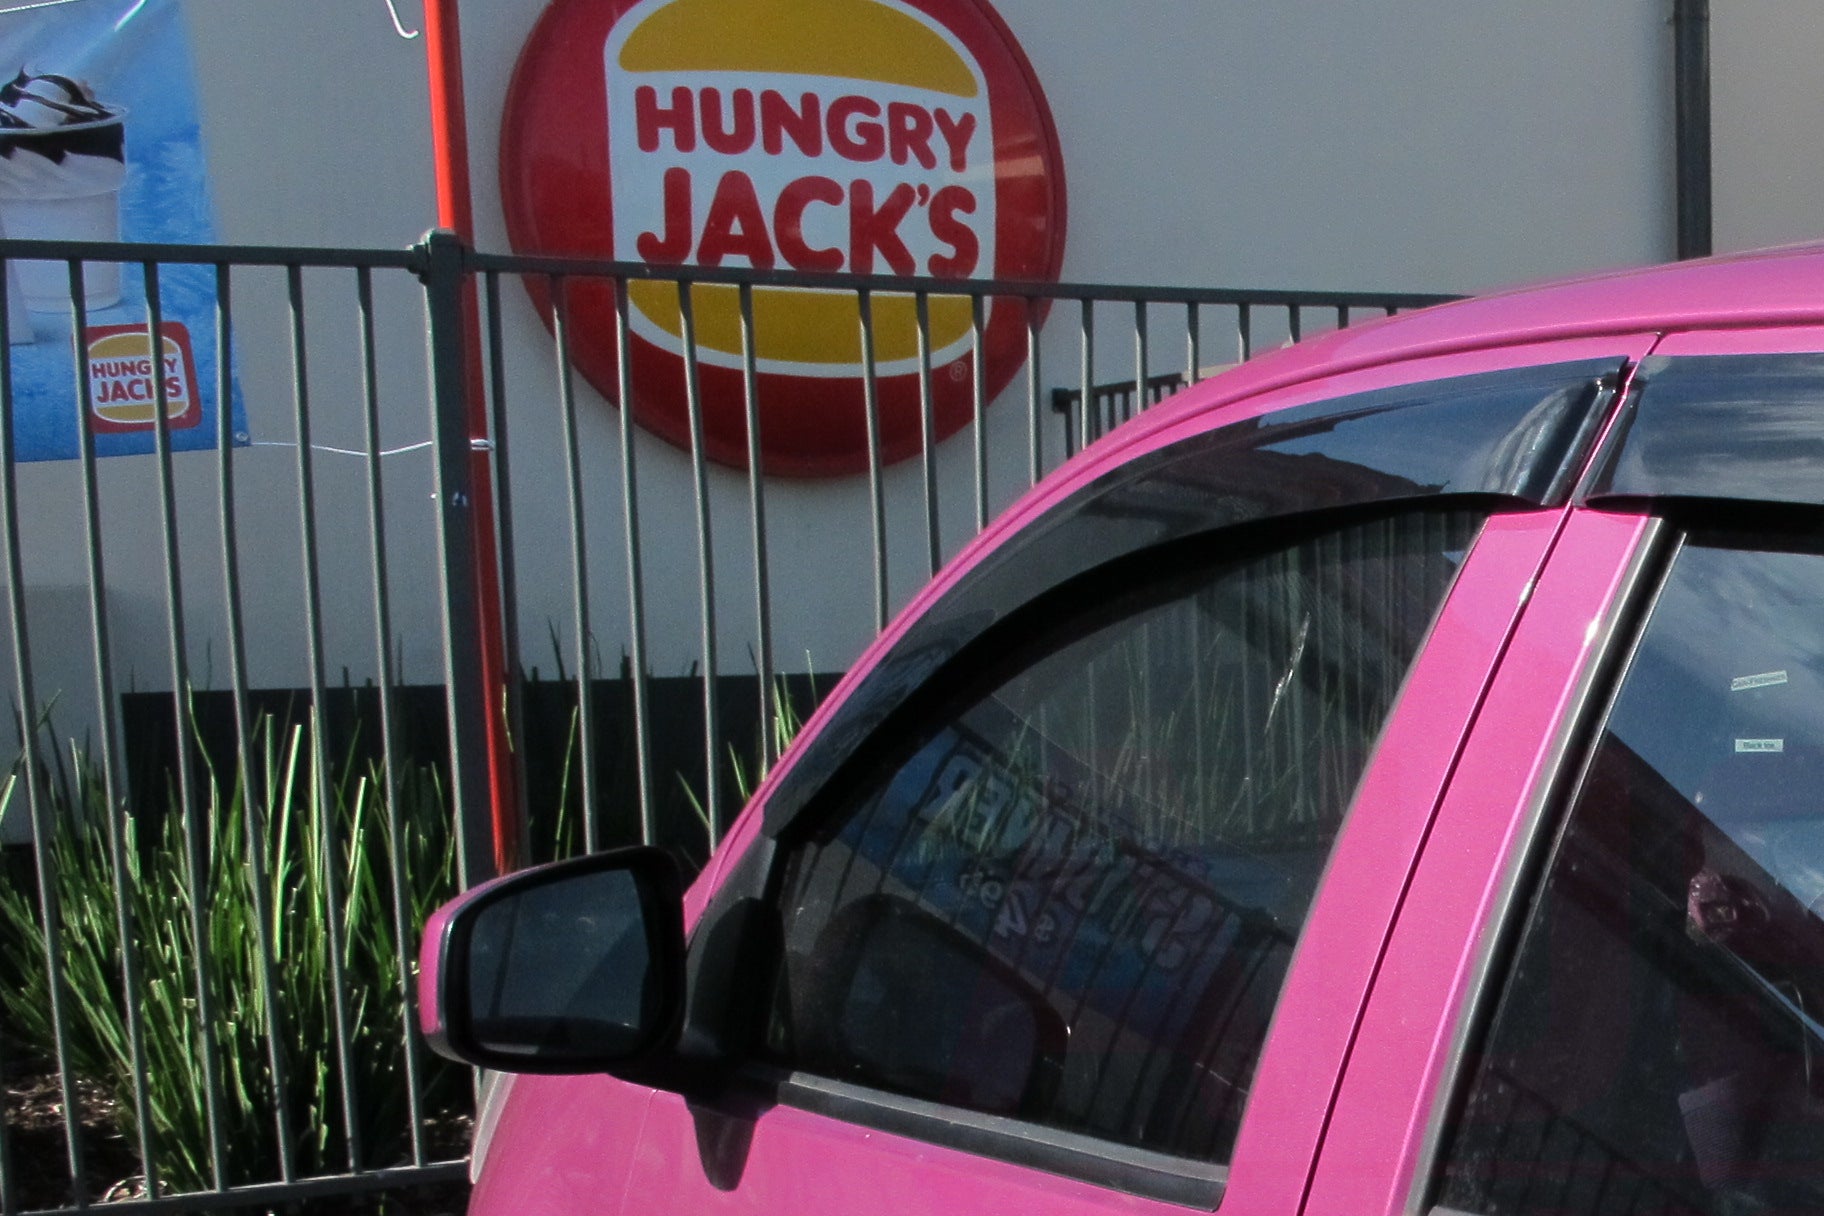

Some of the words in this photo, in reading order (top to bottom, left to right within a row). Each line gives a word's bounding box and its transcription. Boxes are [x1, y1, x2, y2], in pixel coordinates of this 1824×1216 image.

[635, 86, 977, 172] HUNGRY
[636, 167, 980, 279] JACK'S
[92, 358, 177, 378] HUNGY
